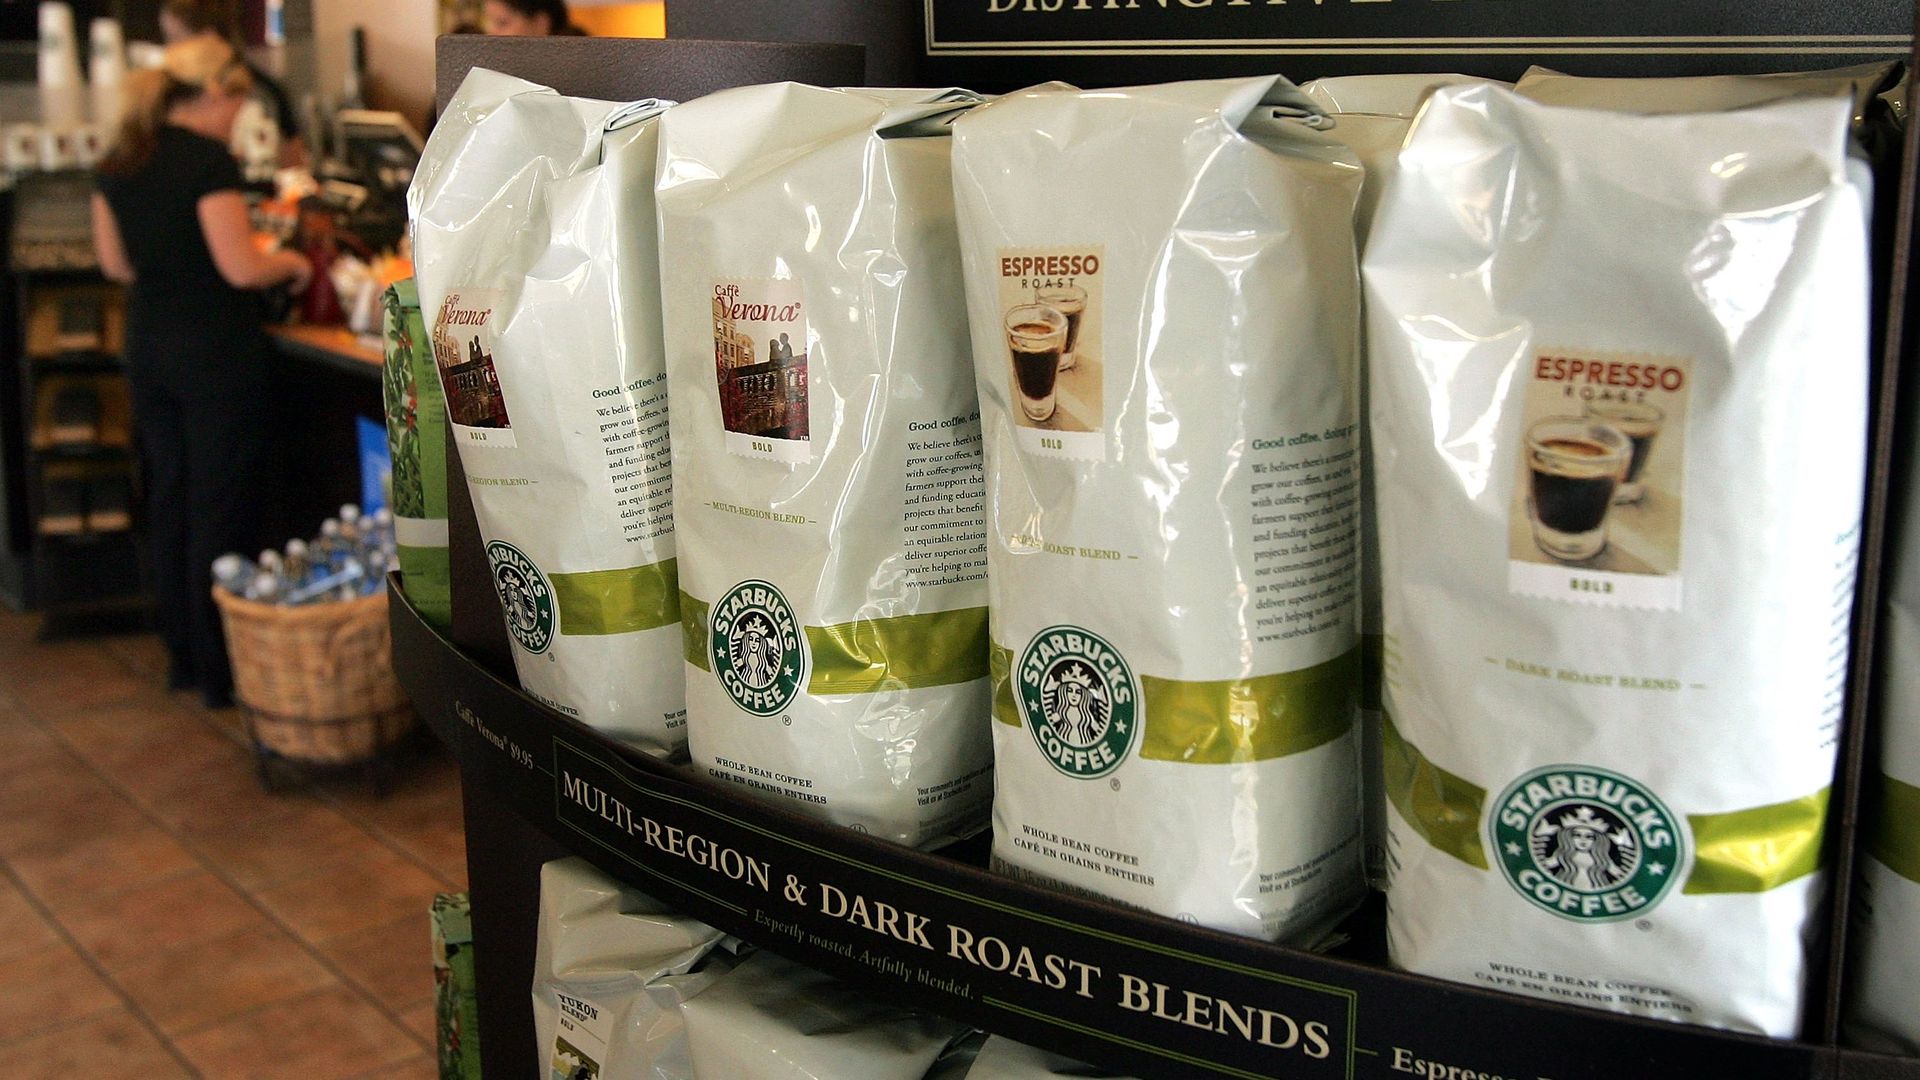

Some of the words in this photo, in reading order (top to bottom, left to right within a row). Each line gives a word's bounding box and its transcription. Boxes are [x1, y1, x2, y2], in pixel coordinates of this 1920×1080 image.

[1001, 254, 1100, 277] ESPRESSO
[715, 284, 740, 297] Caffè
[1021, 278, 1075, 289] ROAST
[1535, 356, 1684, 392] ESPRESSO
[592, 386, 621, 399] Good
[623, 377, 655, 394] coffee,
[596, 408, 610, 418] We
[611, 401, 638, 416] believe
[600, 421, 619, 433] grow
[621, 418, 634, 427] our
[636, 410, 660, 423] coffees,
[908, 420, 938, 432] Good
[940, 415, 968, 429] coffee,
[469, 431, 487, 440] BOLD
[602, 432, 620, 443] with
[605, 444, 635, 456] farmers
[636, 433, 664, 450] support
[1040, 437, 1063, 449] BOLD
[1252, 437, 1285, 450] Good
[1287, 432, 1322, 446] coffee,
[751, 441, 773, 453] BOLD
[908, 442, 921, 451] We
[923, 440, 951, 450] believe
[608, 458, 624, 469] and
[625, 451, 656, 467] funding
[906, 458, 928, 468] grow
[944, 450, 973, 462] coffees,
[1252, 463, 1267, 473] We
[1269, 461, 1300, 472] believe
[611, 469, 642, 484] projects
[643, 464, 658, 475] that
[906, 469, 925, 479] with
[926, 462, 984, 475] coffee-growing
[614, 485, 629, 494] our
[905, 482, 935, 492] farmers
[936, 477, 967, 489] support
[1251, 483, 1274, 495] grow
[1276, 480, 1292, 488] our
[628, 489, 663, 506] equitable
[905, 495, 920, 505] and
[921, 492, 954, 503] funding
[1251, 496, 1273, 507] with
[620, 507, 646, 519] deliver
[712, 501, 771, 520] MULTI-REGION
[773, 512, 806, 525] BLEND
[904, 509, 936, 521] projects
[937, 505, 954, 515] that
[956, 502, 984, 514] benefit
[1252, 514, 1286, 525] farmers
[1288, 509, 1320, 523] support
[622, 520, 646, 533] you're
[647, 512, 674, 526] helping
[904, 525, 919, 533] our
[920, 520, 974, 532] commitment
[975, 518, 984, 526] to
[916, 533, 955, 548] equitable
[1254, 530, 1271, 542] and
[1273, 525, 1307, 540] funding
[904, 550, 932, 561] deliver
[934, 547, 968, 560] superior
[1079, 546, 1121, 560] BLEND
[1254, 548, 1289, 562] projects
[1291, 543, 1308, 555] that
[487, 546, 546, 598] ARBUCKS
[905, 564, 930, 578] you're
[931, 561, 962, 574] helping
[963, 560, 972, 568] to
[1255, 567, 1272, 576] our
[1273, 558, 1324, 574] commitment
[1256, 584, 1268, 593] an
[1269, 576, 1308, 593] equitable
[1256, 598, 1286, 610] deliver
[1288, 592, 1318, 607] superior
[715, 587, 798, 653] STARBUCKS
[1256, 613, 1283, 629] you're
[1284, 609, 1314, 624] helping
[1023, 633, 1132, 705] STARBUCKS
[723, 669, 786, 710] COFFEE
[1617, 674, 1682, 691] BLEND
[664, 712, 676, 721] Your
[666, 719, 678, 729] Visit
[510, 742, 533, 770] $9.95
[1038, 724, 1117, 772] COFFEE
[715, 756, 747, 772] WHOLE
[748, 765, 772, 780] BEAN
[774, 773, 813, 789] COFFEE
[708, 767, 732, 781] CAFÉ
[733, 773, 746, 785] EN
[747, 777, 783, 796] GRAINS
[784, 787, 828, 805] ENTIERS
[917, 788, 929, 797] Your
[917, 798, 930, 807] Visit
[1501, 774, 1673, 849] STARBUCKS
[1022, 824, 1059, 844] WHOLE
[1061, 836, 1092, 853] BEAN
[1093, 846, 1140, 867] COFFEE
[1013, 837, 1041, 854] CAFÉ
[1042, 847, 1057, 859] EN
[1059, 852, 1102, 873] GRAINS
[1103, 865, 1156, 888] ENTIERS
[1260, 872, 1274, 882] Your
[1260, 883, 1273, 893] Visit
[1519, 869, 1647, 916] COFFEE
[562, 769, 771, 893] MULTI-REGION
[783, 873, 809, 907] &
[819, 882, 935, 951] DARK
[946, 923, 1102, 1000] ROAST
[1117, 973, 1331, 1060] BLENDS
[754, 908, 805, 944] Expertly
[809, 933, 858, 960] roasted.
[858, 949, 913, 983] Artfully
[917, 967, 975, 1000] blended.
[1489, 961, 1548, 981] WHOLE
[1552, 973, 1600, 990] BEAN
[1604, 978, 1673, 997] COFFEE
[1474, 970, 1517, 987] CAFÉ
[1521, 981, 1544, 992] EN
[1548, 986, 1613, 1002] GRAINS
[1617, 994, 1694, 1014] ENTIERS
[558, 993, 599, 1021] YUKON
[1390, 1046, 1518, 1080] Espre
